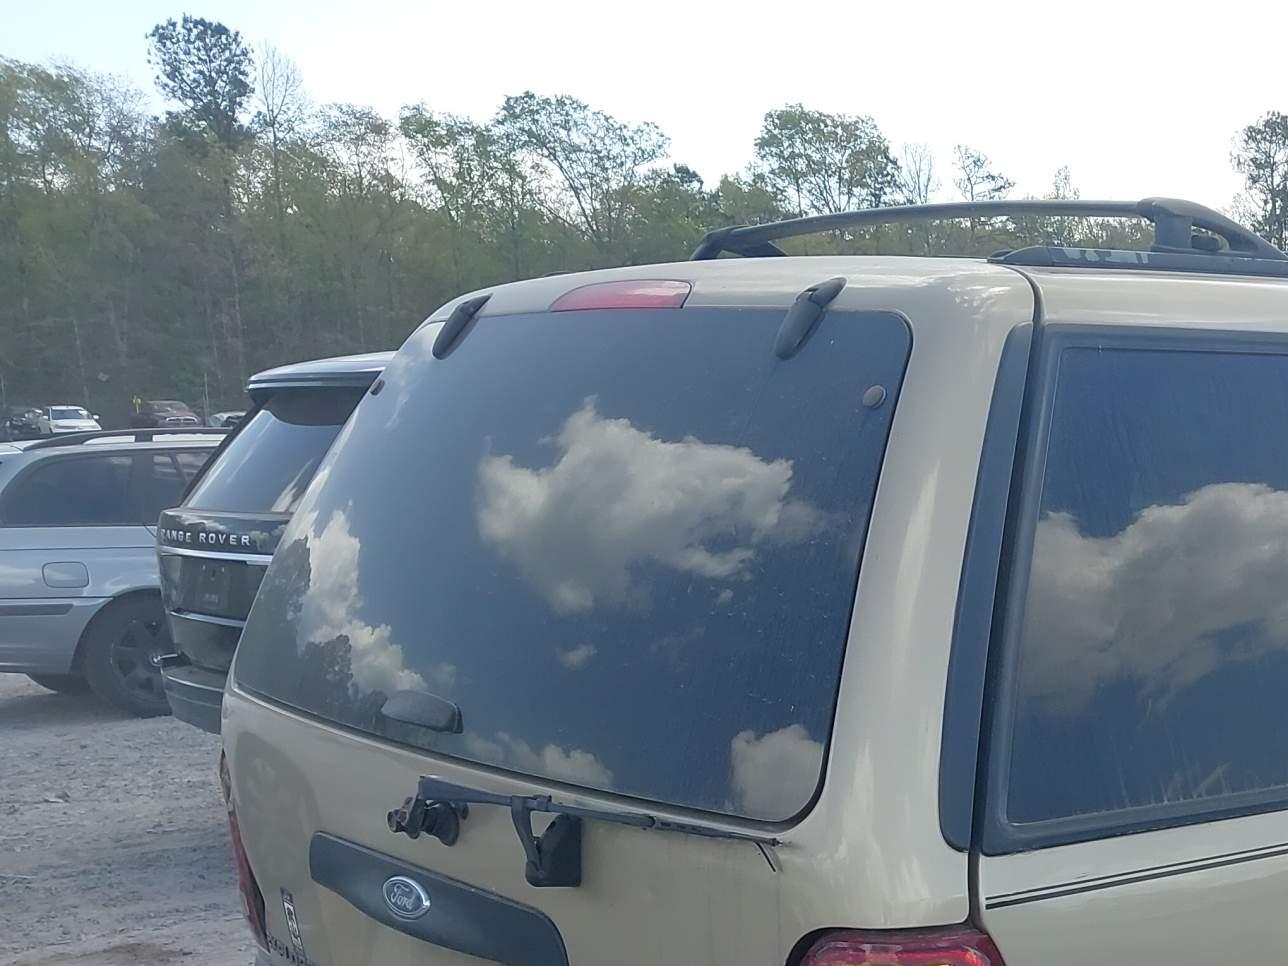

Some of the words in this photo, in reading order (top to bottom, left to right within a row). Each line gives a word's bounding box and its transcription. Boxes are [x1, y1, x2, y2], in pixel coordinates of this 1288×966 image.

[160, 529, 192, 543] RANGE
[199, 532, 251, 546] ROVER
[388, 885, 418, 911] Ford
